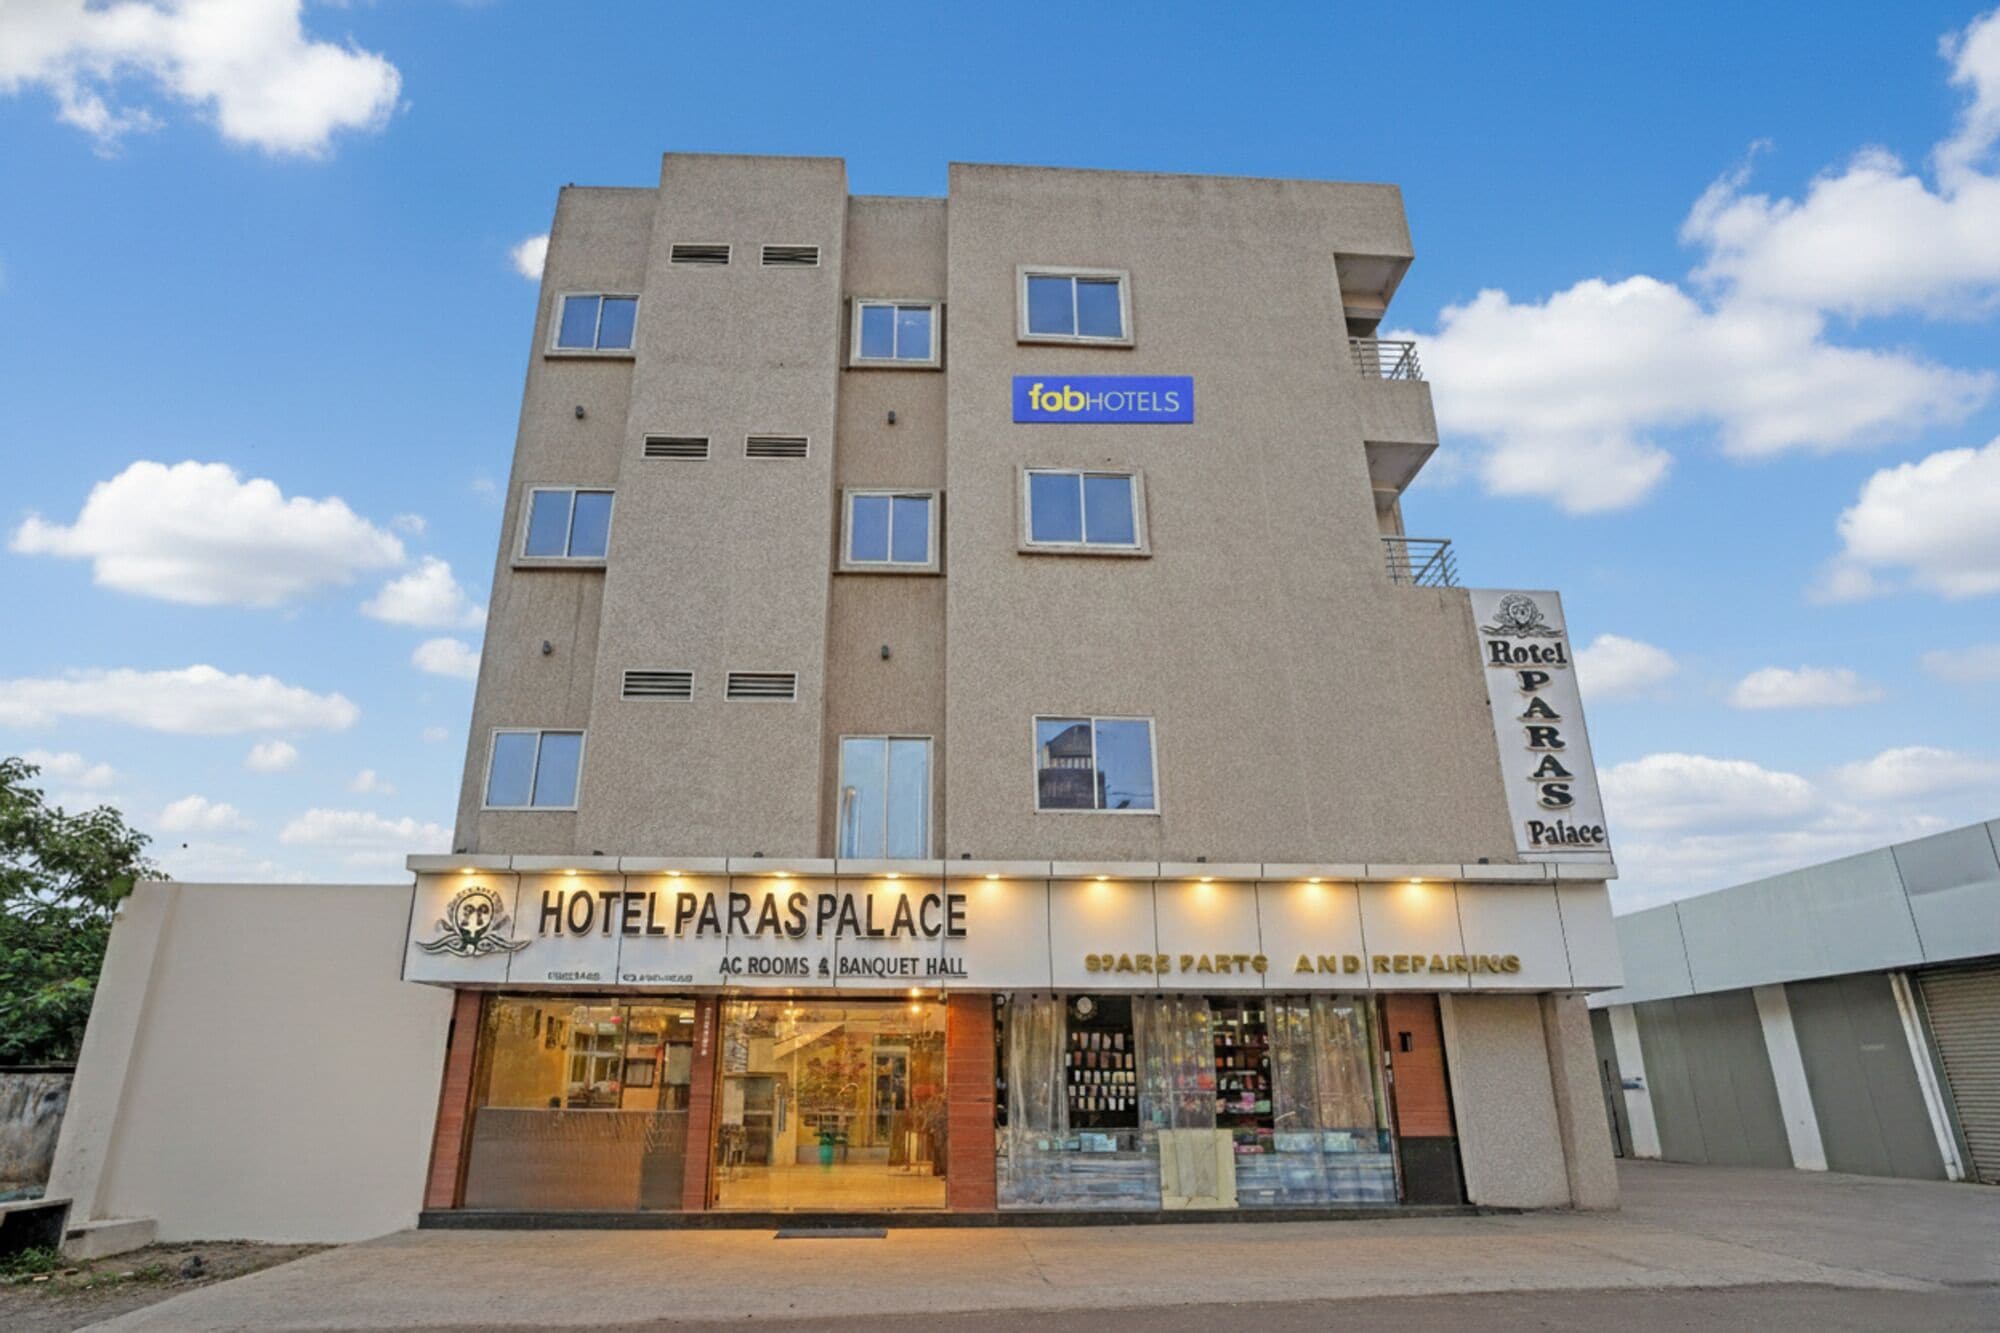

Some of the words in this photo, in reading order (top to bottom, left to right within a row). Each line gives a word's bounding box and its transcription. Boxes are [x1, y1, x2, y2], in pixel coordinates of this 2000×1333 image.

[1028, 383, 1180, 412] fobHOTELS
[1518, 670, 1573, 805] PARAS
[1527, 819, 1604, 845] Palace
[538, 890, 666, 935] HOTEL
[674, 891, 808, 937] PARAS
[816, 893, 967, 938] PALACE
[719, 956, 742, 975] AC
[749, 956, 809, 975] ROOMS
[817, 957, 830, 975] &
[838, 957, 919, 978] BANQUET
[926, 957, 968, 976] HALL
[1085, 953, 1170, 974] SPARE
[1180, 953, 1268, 974] PARTS
[1295, 953, 1361, 974] AND
[1372, 953, 1521, 974] REPAIRING
